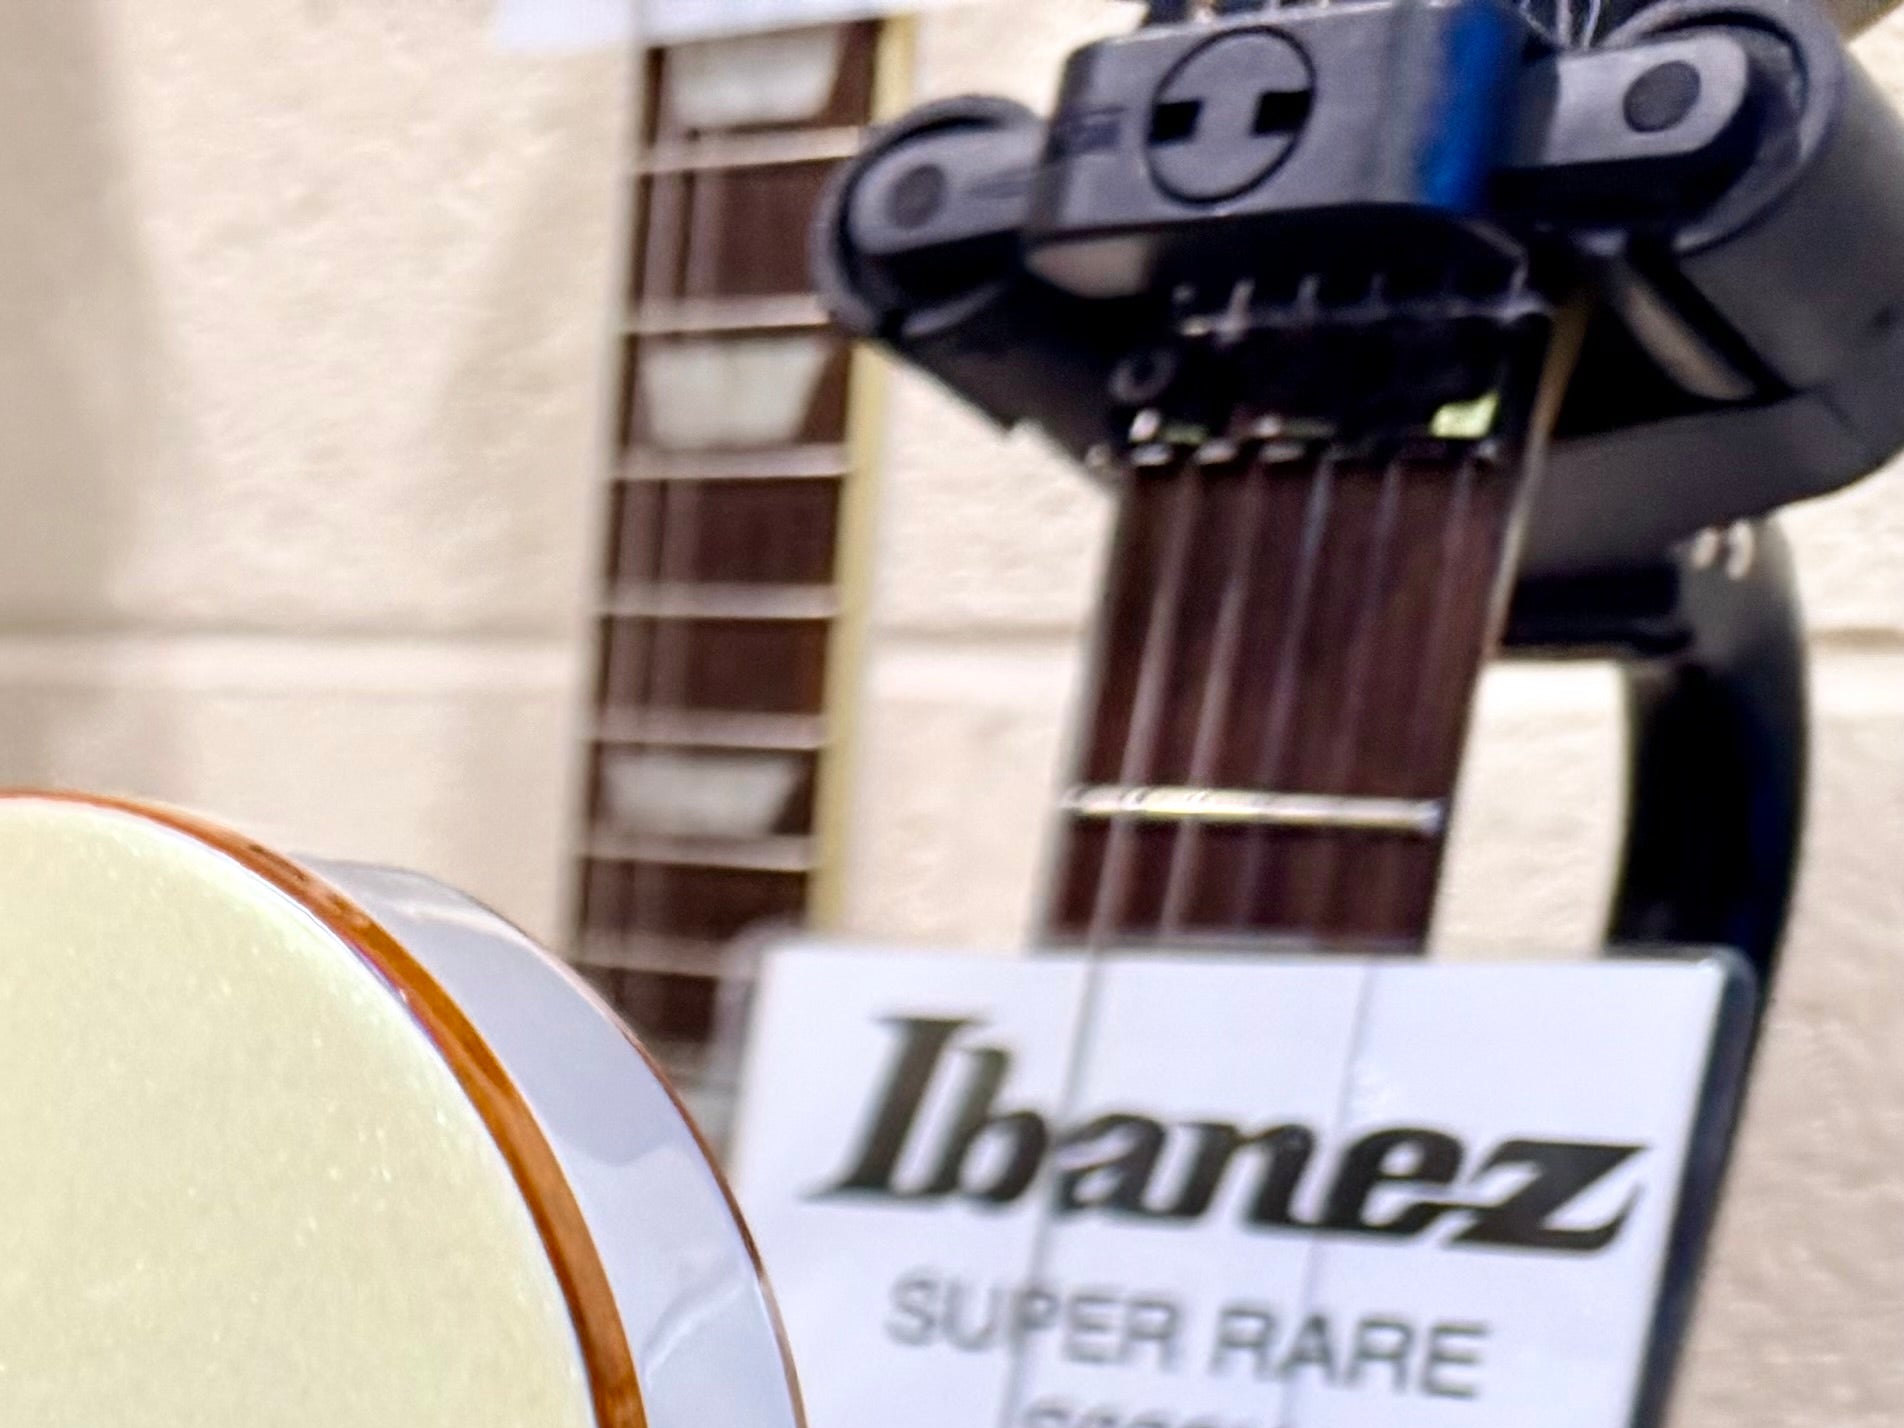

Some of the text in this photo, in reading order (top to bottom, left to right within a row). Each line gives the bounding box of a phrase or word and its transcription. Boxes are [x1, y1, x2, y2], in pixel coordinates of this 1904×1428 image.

[804, 1012, 1650, 1254] Ibanez
[886, 1271, 1489, 1399] SUPER RARE
